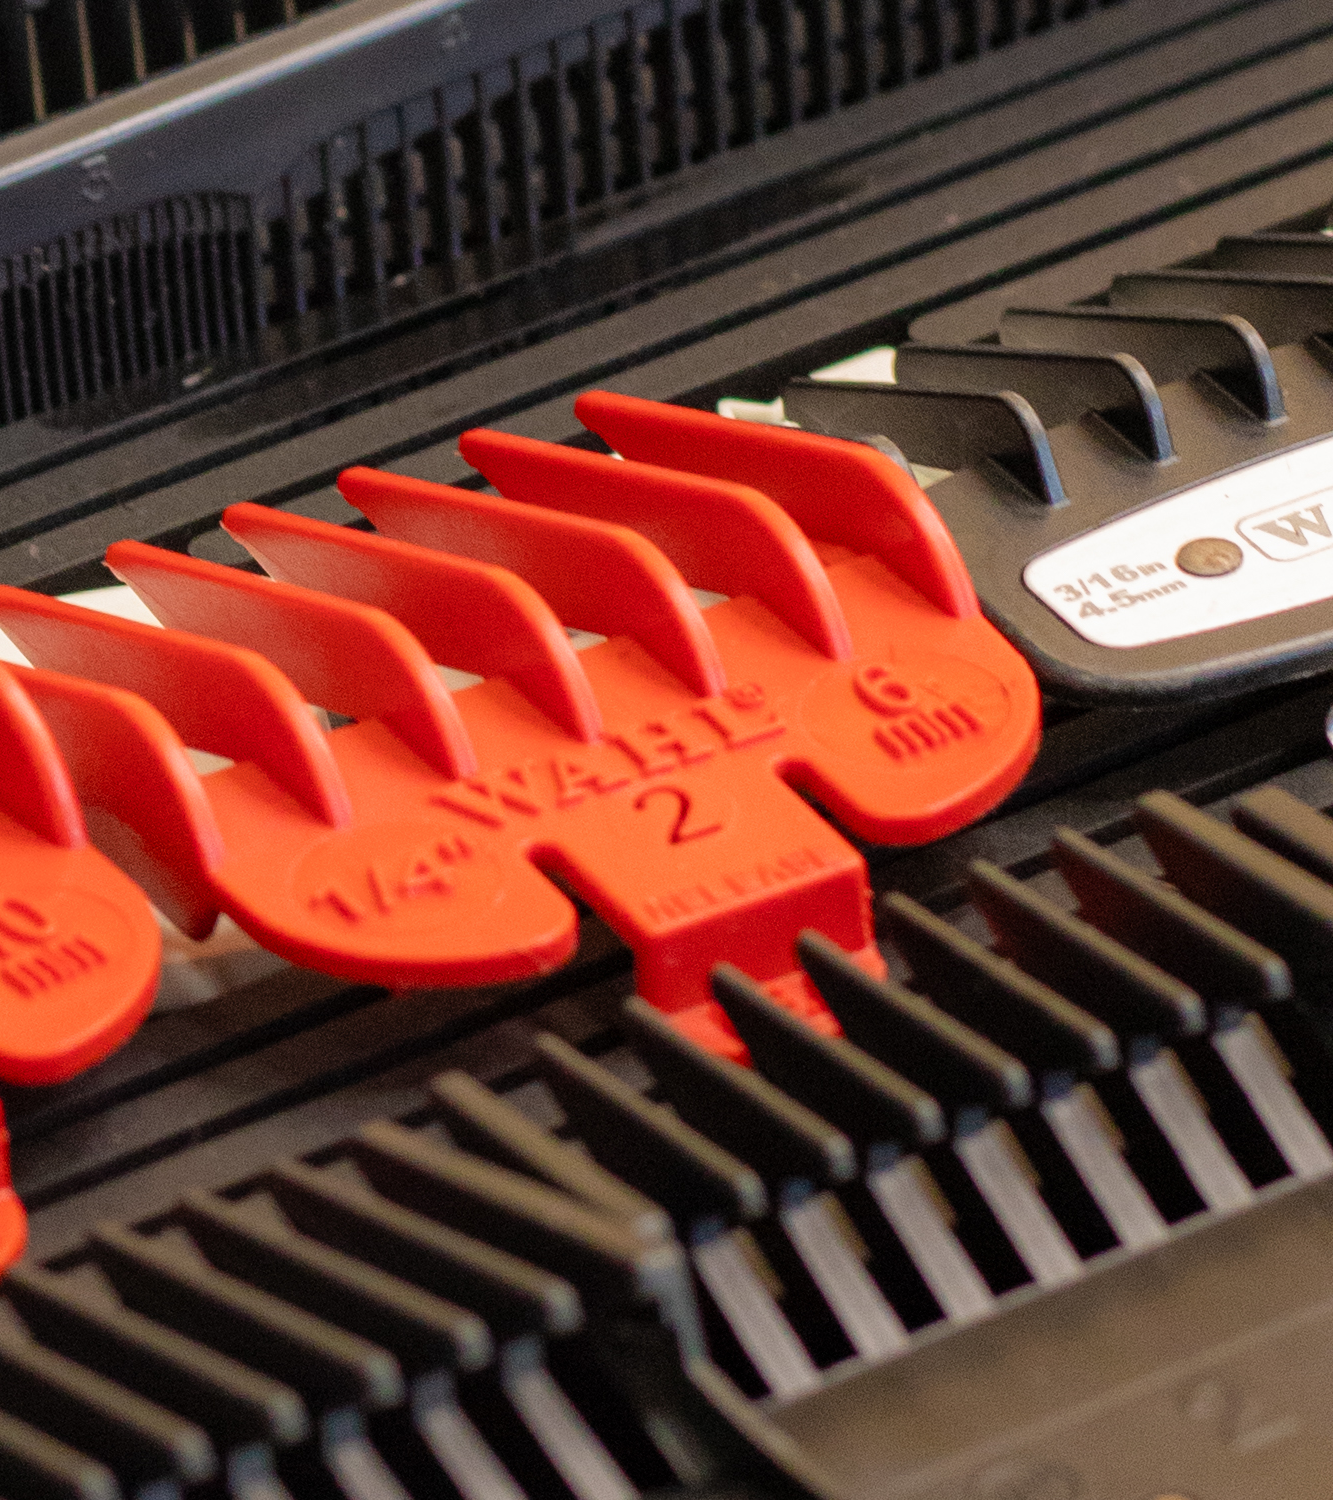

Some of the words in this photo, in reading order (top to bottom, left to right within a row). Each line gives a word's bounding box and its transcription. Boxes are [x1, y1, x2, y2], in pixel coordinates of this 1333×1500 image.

[1053, 560, 1168, 603] 3/16in
[1078, 579, 1188, 620] 4.5mm
[851, 666, 911, 719] 6
[634, 785, 724, 846] 2
